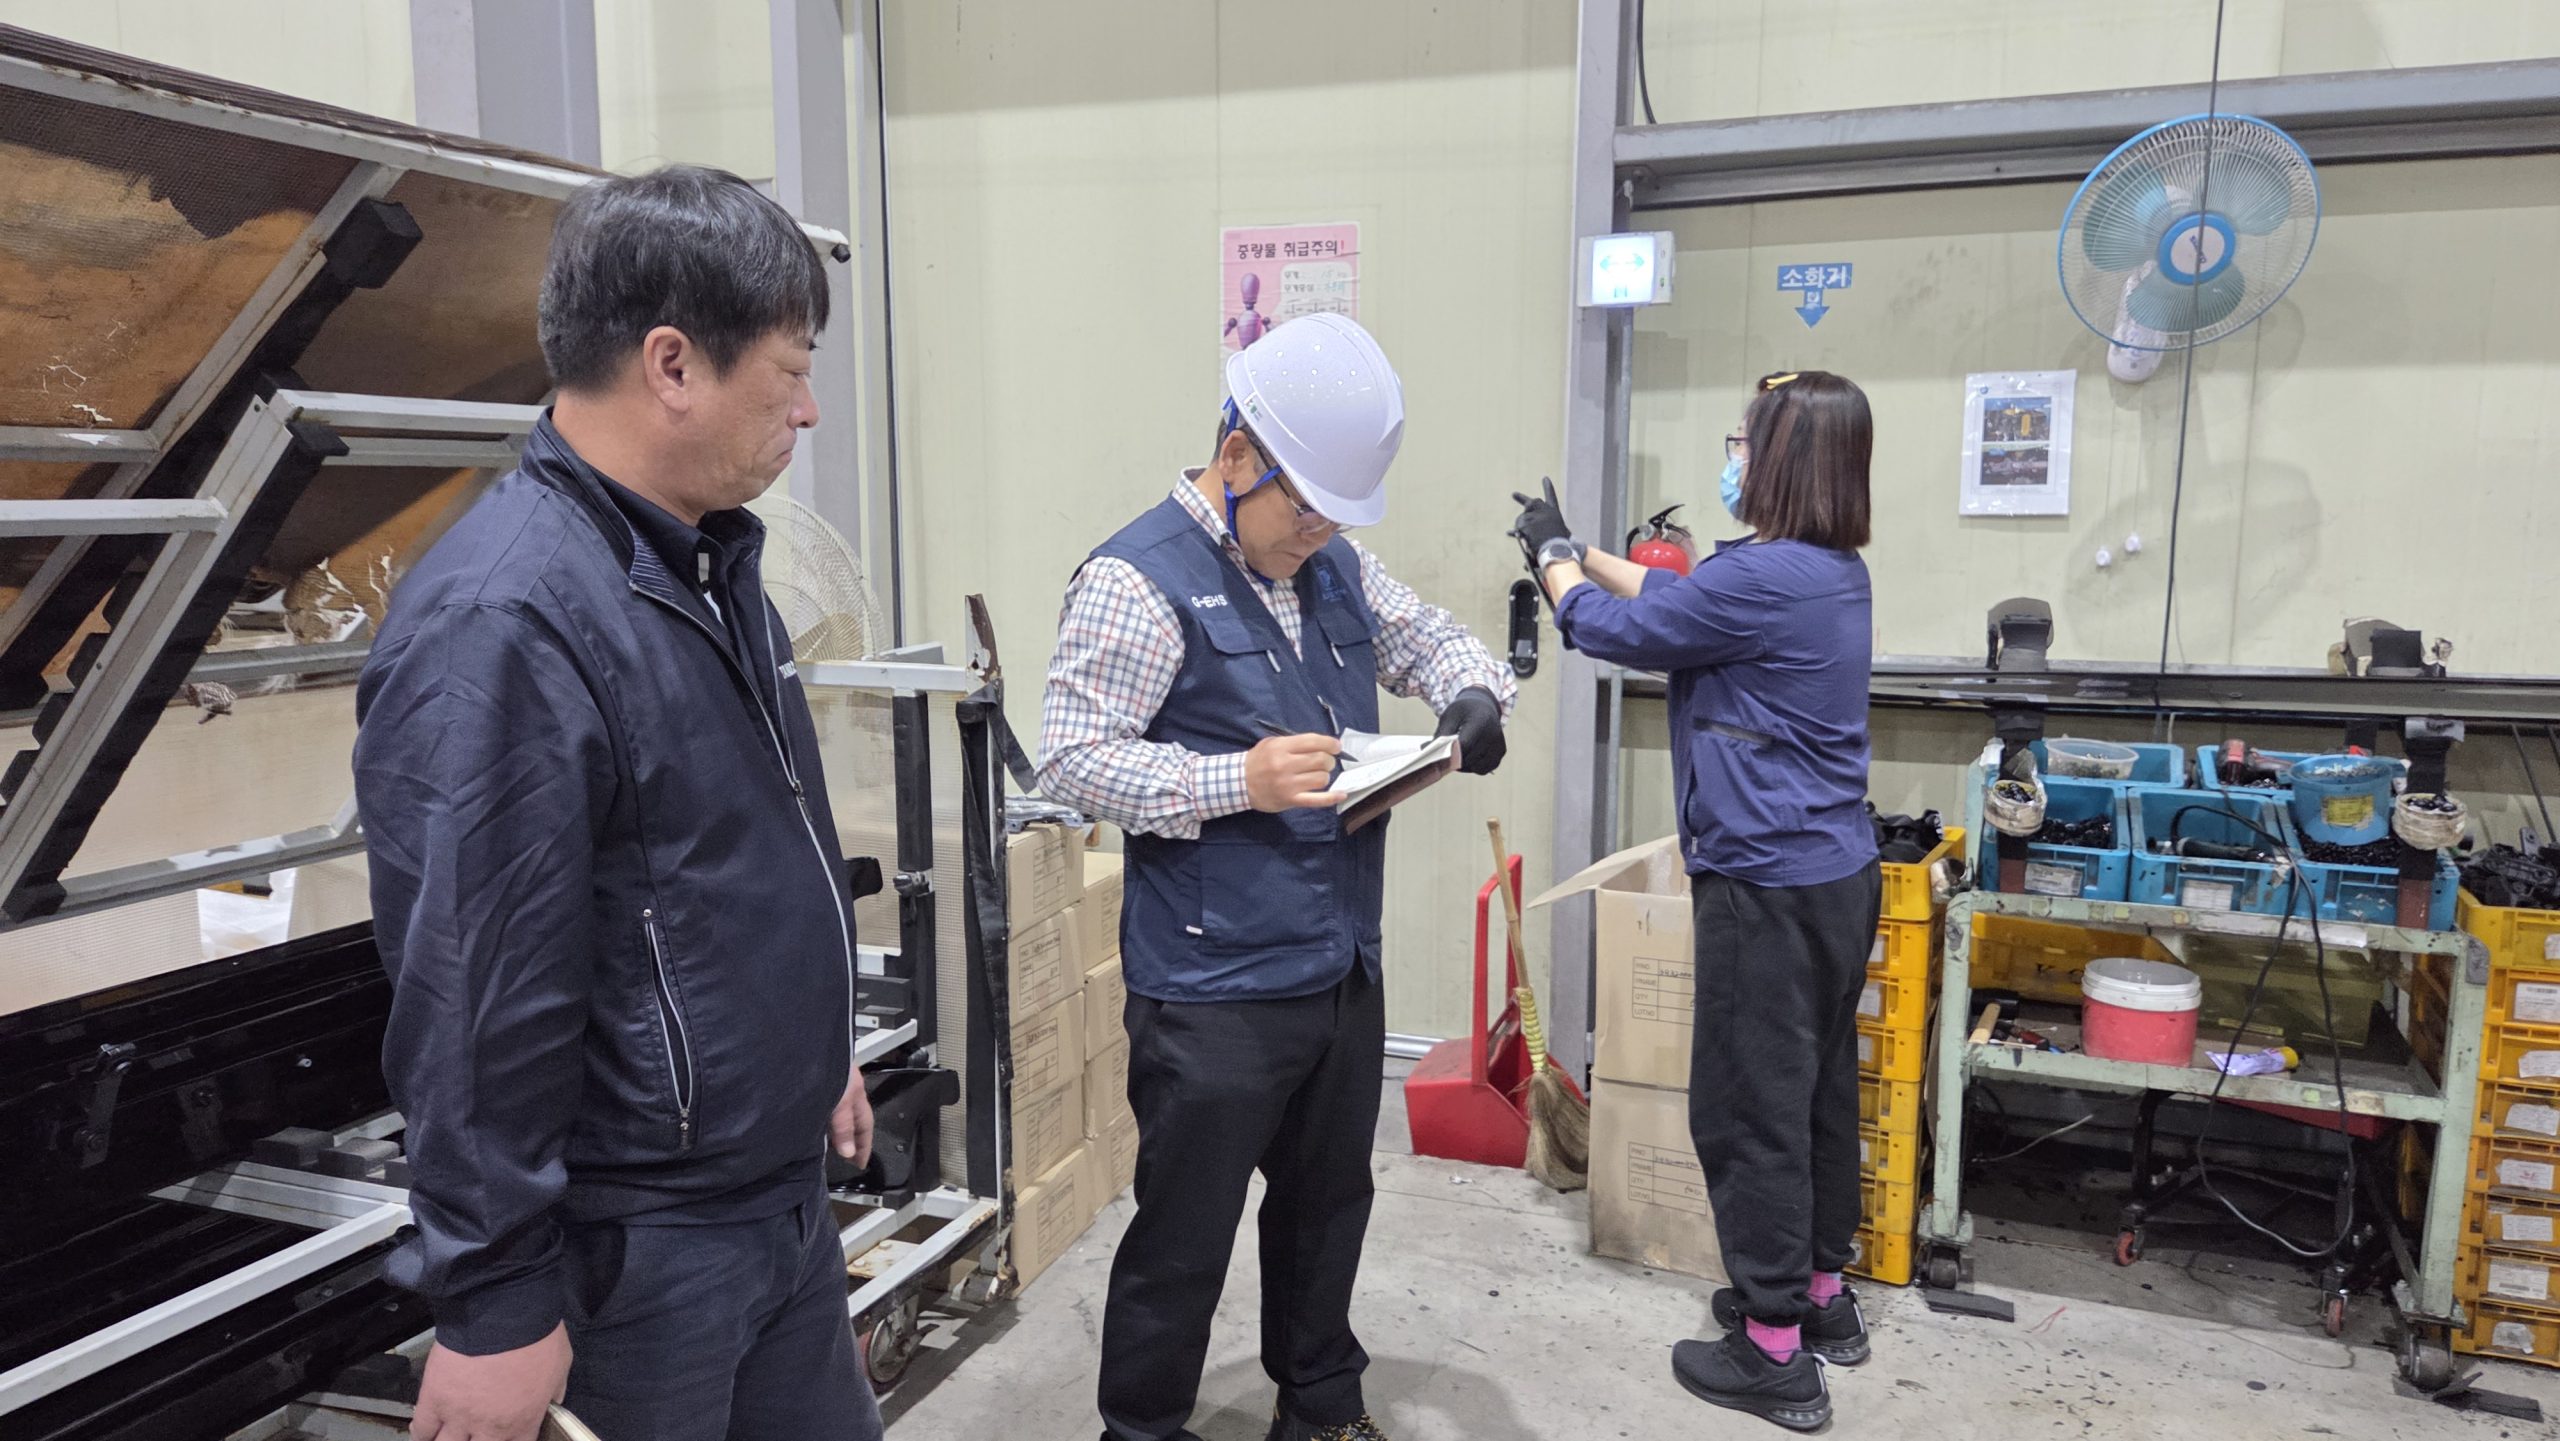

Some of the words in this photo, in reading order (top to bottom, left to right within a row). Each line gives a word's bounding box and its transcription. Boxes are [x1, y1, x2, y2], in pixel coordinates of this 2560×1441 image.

[1238, 243, 1276, 260] 중량물
[1283, 240, 1345, 258] 취급주의!
[1191, 594, 1228, 609] G-EHS
